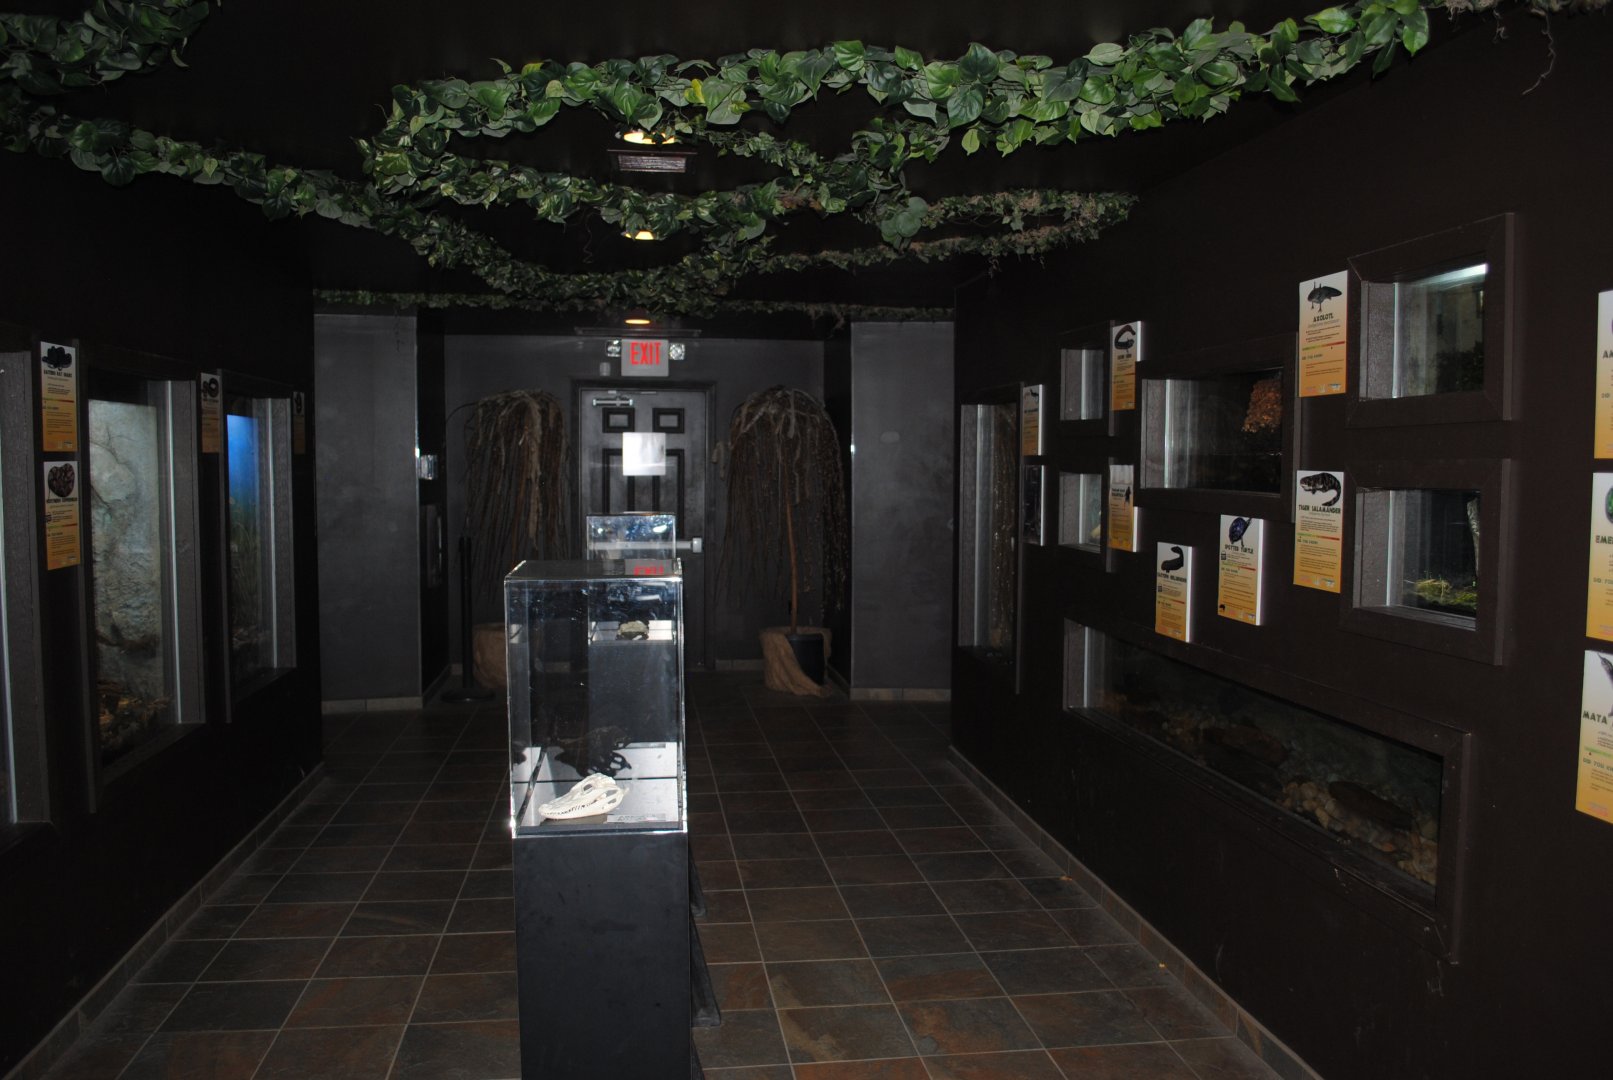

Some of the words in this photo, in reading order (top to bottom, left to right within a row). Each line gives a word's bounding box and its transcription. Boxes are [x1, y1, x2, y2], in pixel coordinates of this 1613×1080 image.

[1313, 312, 1334, 322] AXOLOTL
[630, 341, 661, 366] EXIT
[1298, 504, 1310, 512] TIGER
[1311, 505, 1341, 514] SALAMANDER
[1582, 710, 1608, 725] MATA
